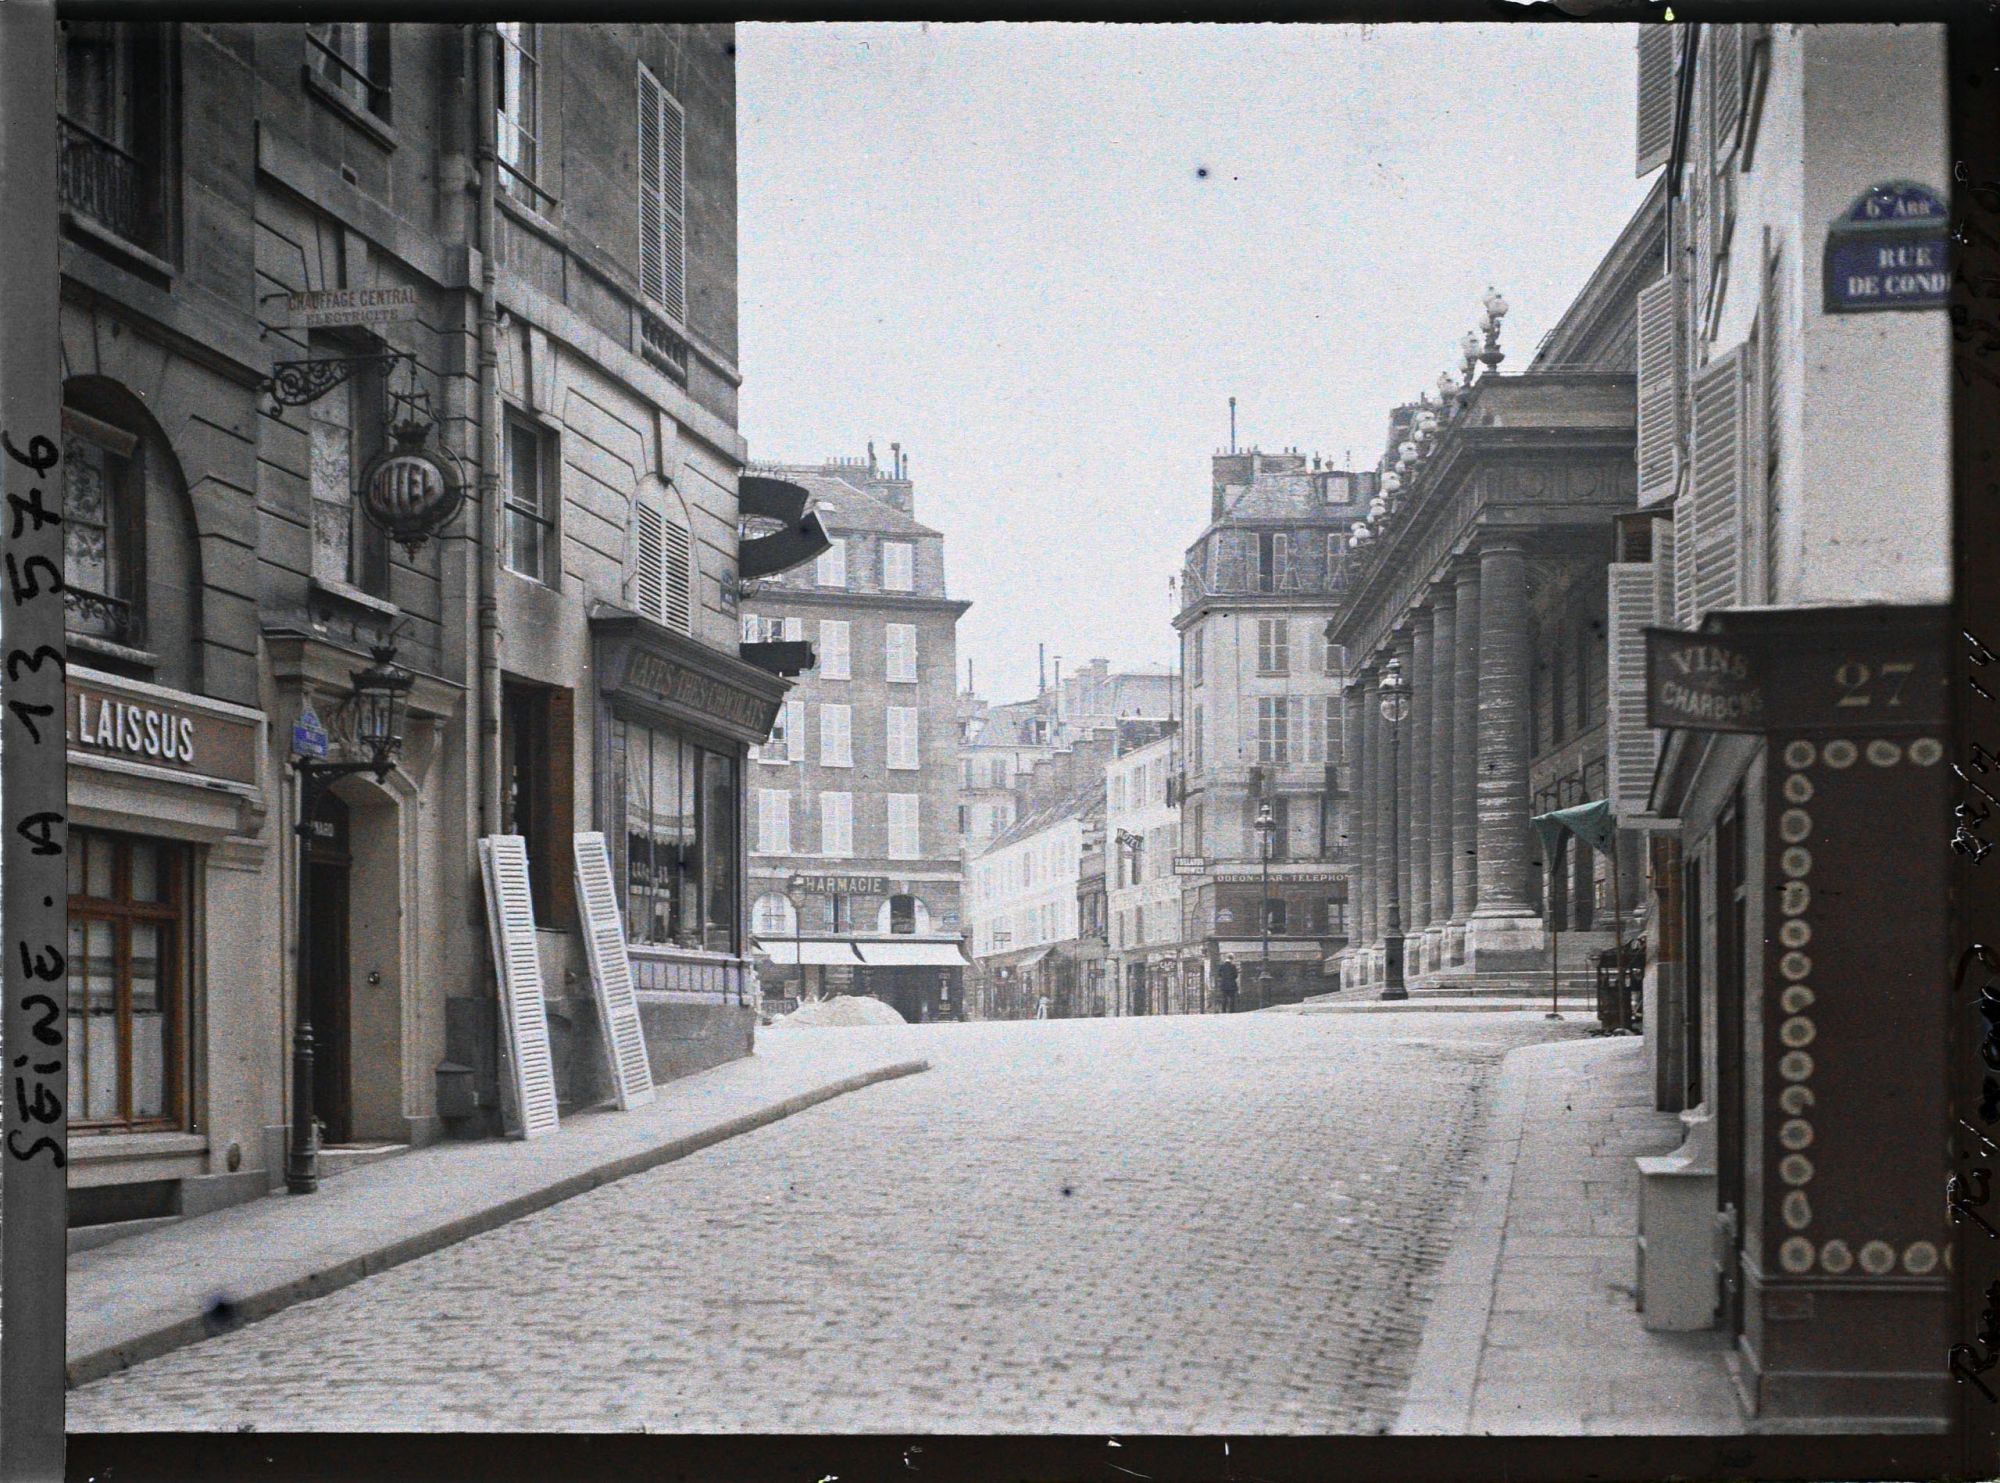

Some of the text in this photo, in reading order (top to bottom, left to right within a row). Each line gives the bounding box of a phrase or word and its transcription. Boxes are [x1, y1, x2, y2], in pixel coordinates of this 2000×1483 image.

[1879, 245, 1933, 268] RUE
[289, 287, 416, 311] CHAUFFAGE CENTRAL
[1848, 275, 1880, 296] DE
[372, 462, 437, 509] HOTEL
[3, 430, 65, 607] 576
[1670, 646, 1749, 680] VINS
[7, 644, 65, 745] 13
[1834, 661, 1916, 708] 27
[79, 693, 194, 762] LAISSUS
[16, 811, 65, 856] A
[1117, 829, 1142, 850] HOTEL
[793, 876, 882, 893] HARMACIE
